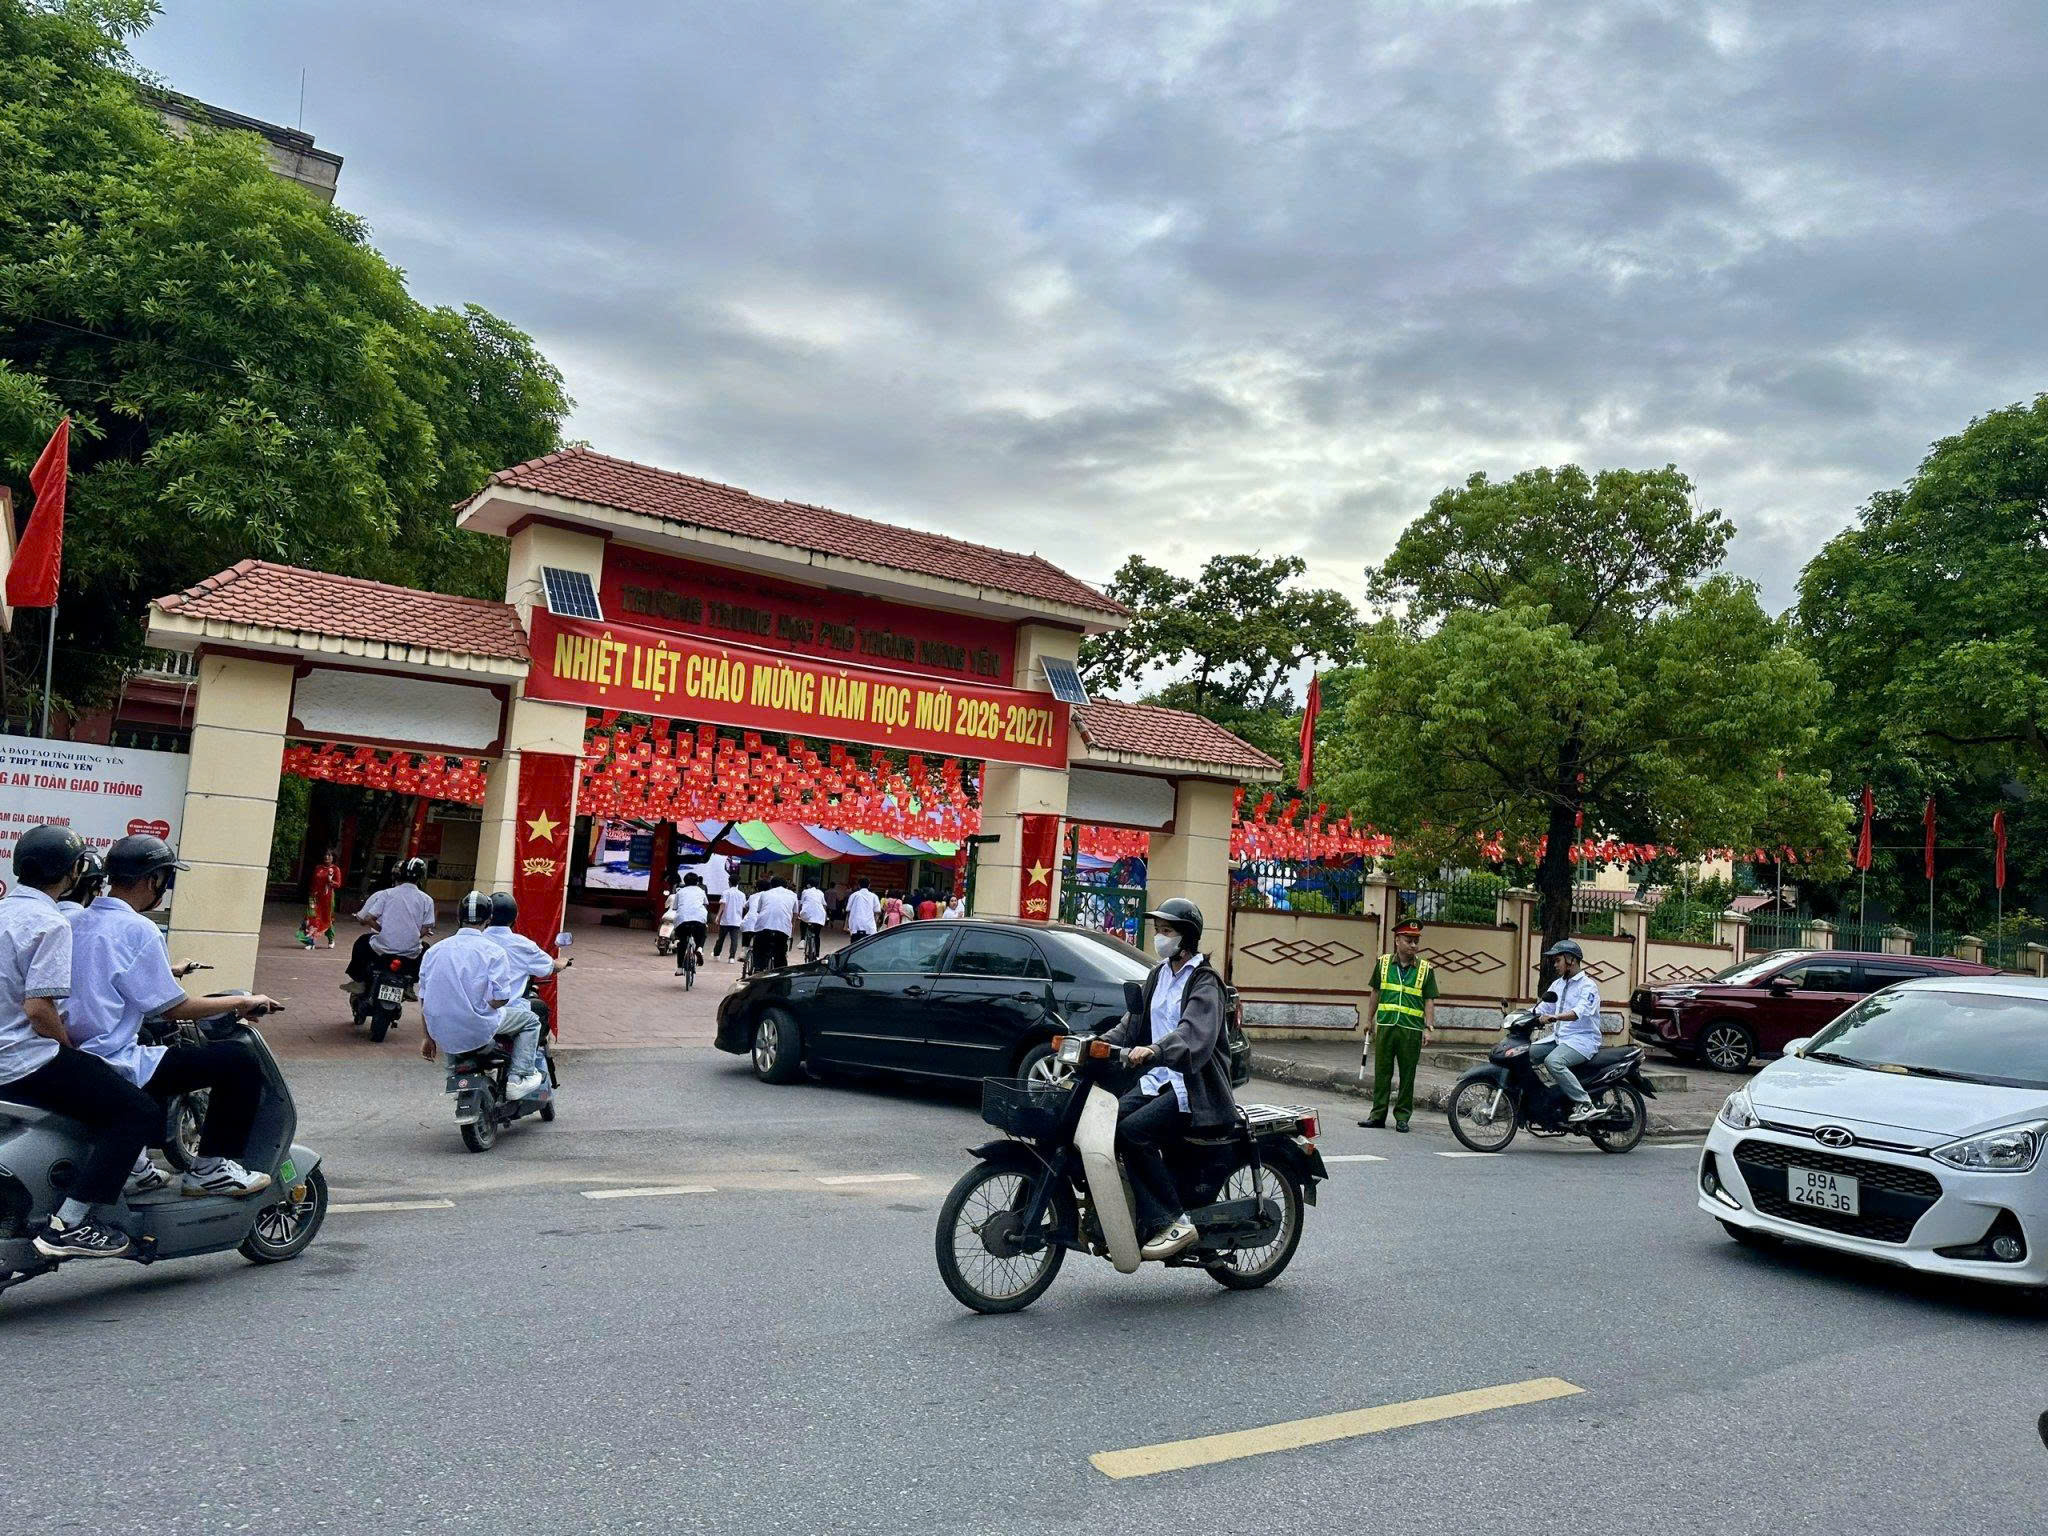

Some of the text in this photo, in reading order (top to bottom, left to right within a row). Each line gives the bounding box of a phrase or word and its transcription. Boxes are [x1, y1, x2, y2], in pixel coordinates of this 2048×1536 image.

[708, 600, 772, 636] TRUNG
[860, 626, 915, 662] THÔNG
[920, 638, 965, 671] HƯNG
[970, 646, 1001, 677] YÊN
[553, 631, 1054, 748] NHIỆT LIỆT CHÀO MỪNG NĂM HỌC MỚI 2026-2027!
[9, 756, 38, 766] THPT
[41, 760, 69, 769] HƯNG
[73, 762, 93, 772] YÊN
[11, 773, 30, 786] AN
[34, 774, 67, 789] TOÀN
[70, 779, 99, 792] GIAO
[103, 781, 143, 796] THÔNG
[12, 813, 25, 823] GIA
[27, 814, 44, 824] GIAO
[1807, 1172, 1837, 1191] 89A
[1795, 1186, 1851, 1212] 246.36
